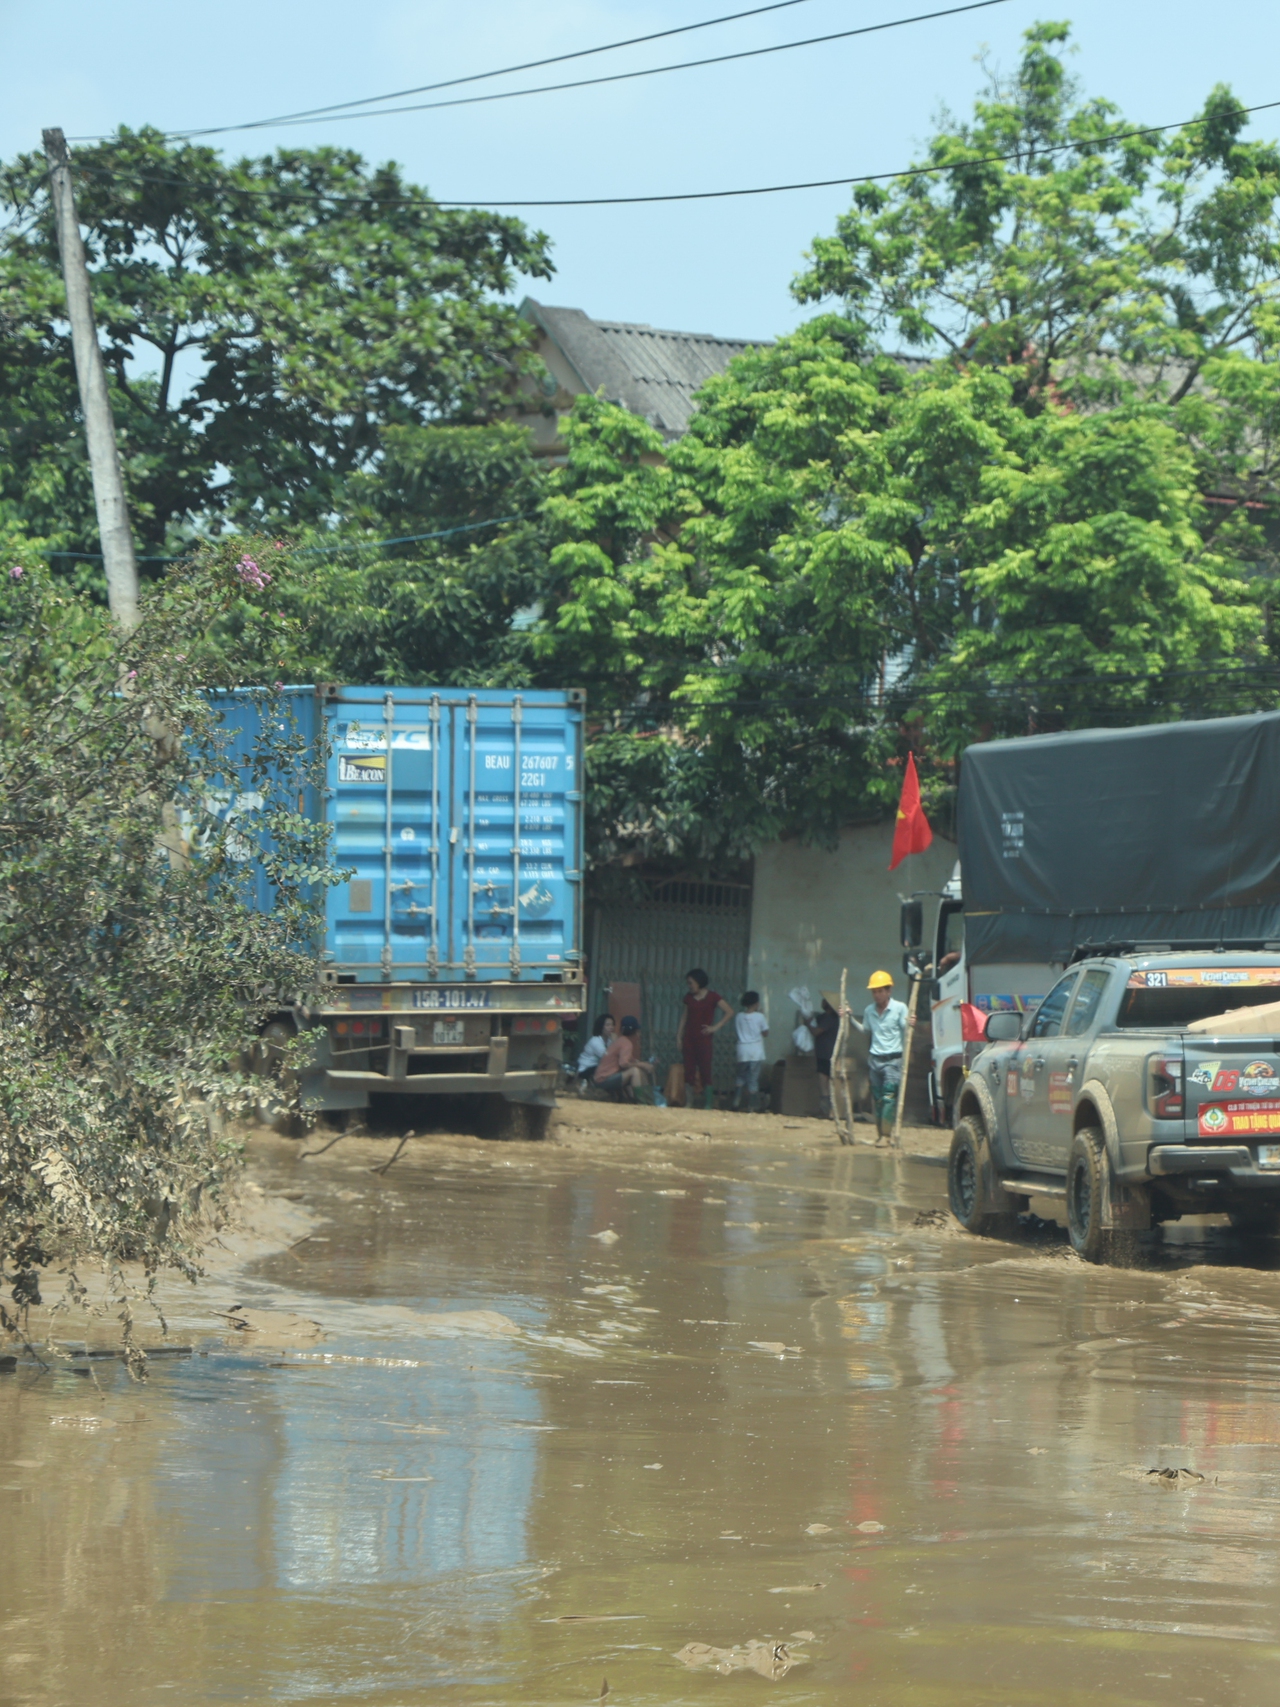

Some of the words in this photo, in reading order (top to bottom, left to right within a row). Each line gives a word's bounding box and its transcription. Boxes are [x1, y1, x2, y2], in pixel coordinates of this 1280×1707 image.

[485, 755, 510, 769] BEAU
[522, 756, 558, 769] 267607
[1148, 973, 1167, 986] 321
[1212, 1069, 1239, 1092] 06
